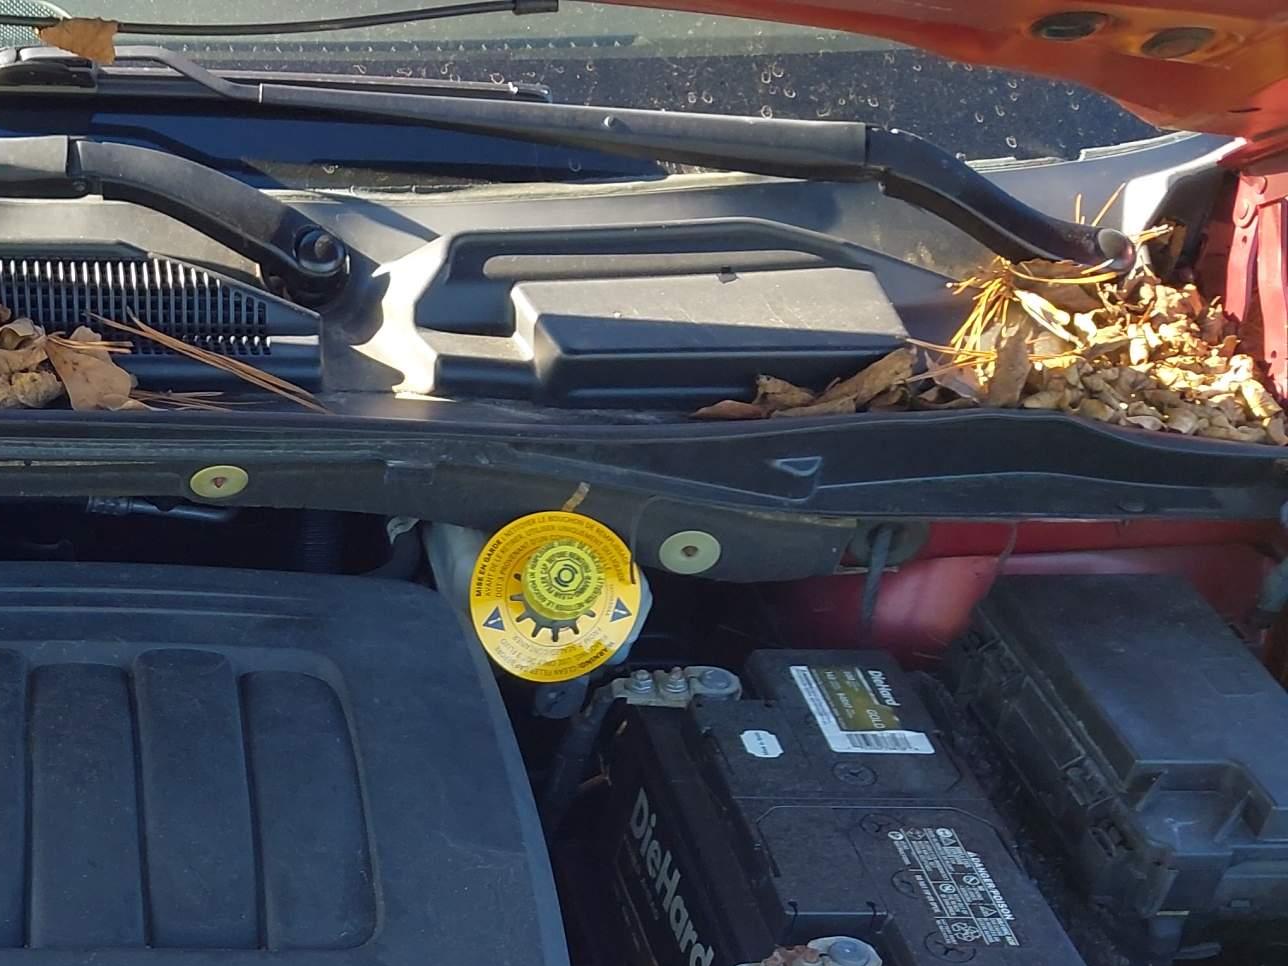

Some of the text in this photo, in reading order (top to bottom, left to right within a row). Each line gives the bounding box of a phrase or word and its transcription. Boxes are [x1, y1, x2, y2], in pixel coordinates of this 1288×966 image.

[482, 537, 504, 563] GARDE
[477, 563, 488, 575] EN
[474, 577, 483, 596] MISE
[868, 669, 902, 707] DieHard
[866, 709, 886, 730] GOLD
